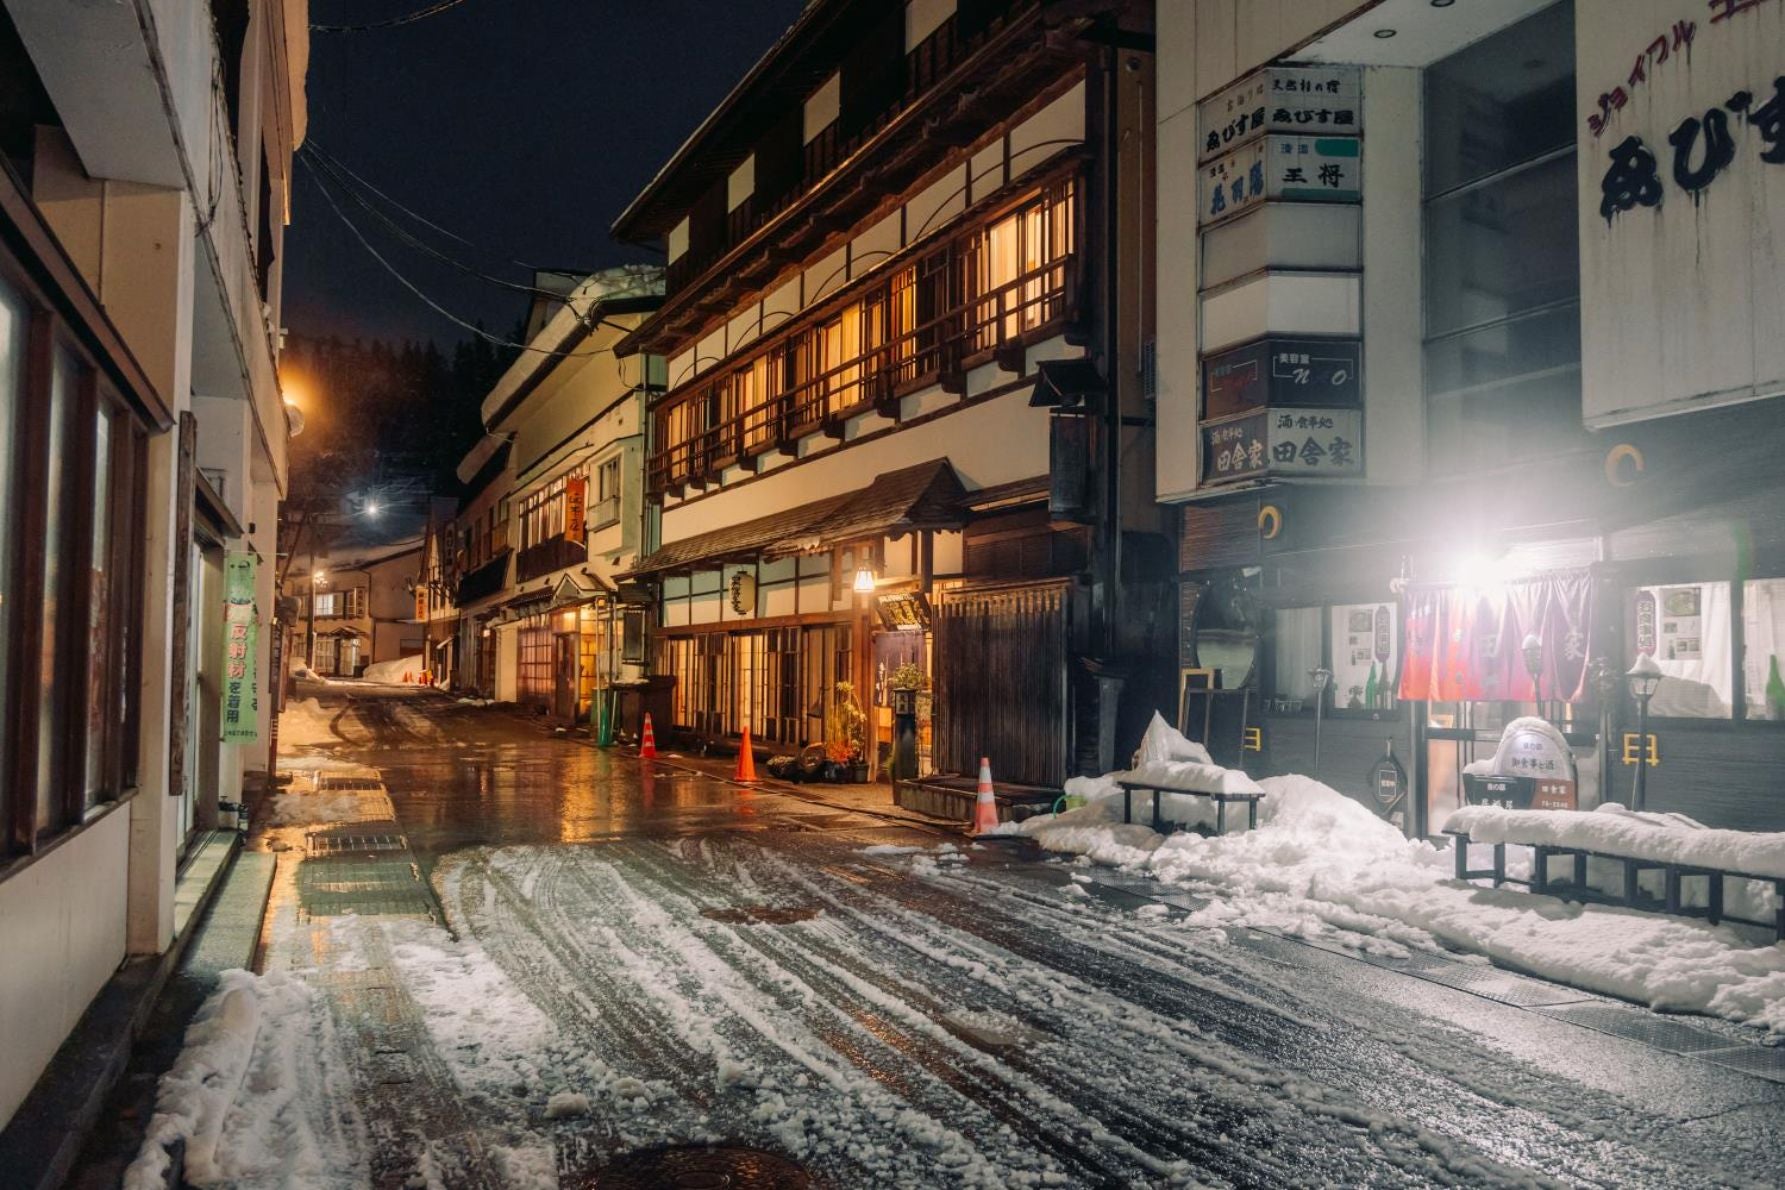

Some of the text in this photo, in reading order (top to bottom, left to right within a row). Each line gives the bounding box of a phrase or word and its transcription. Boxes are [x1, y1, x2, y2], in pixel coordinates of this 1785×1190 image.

[1282, 162, 1345, 188] 王将
[1217, 439, 1264, 472] 田舎家
[1272, 436, 1354, 467] 田舎家
[226, 623, 248, 724] 反射材を着用
